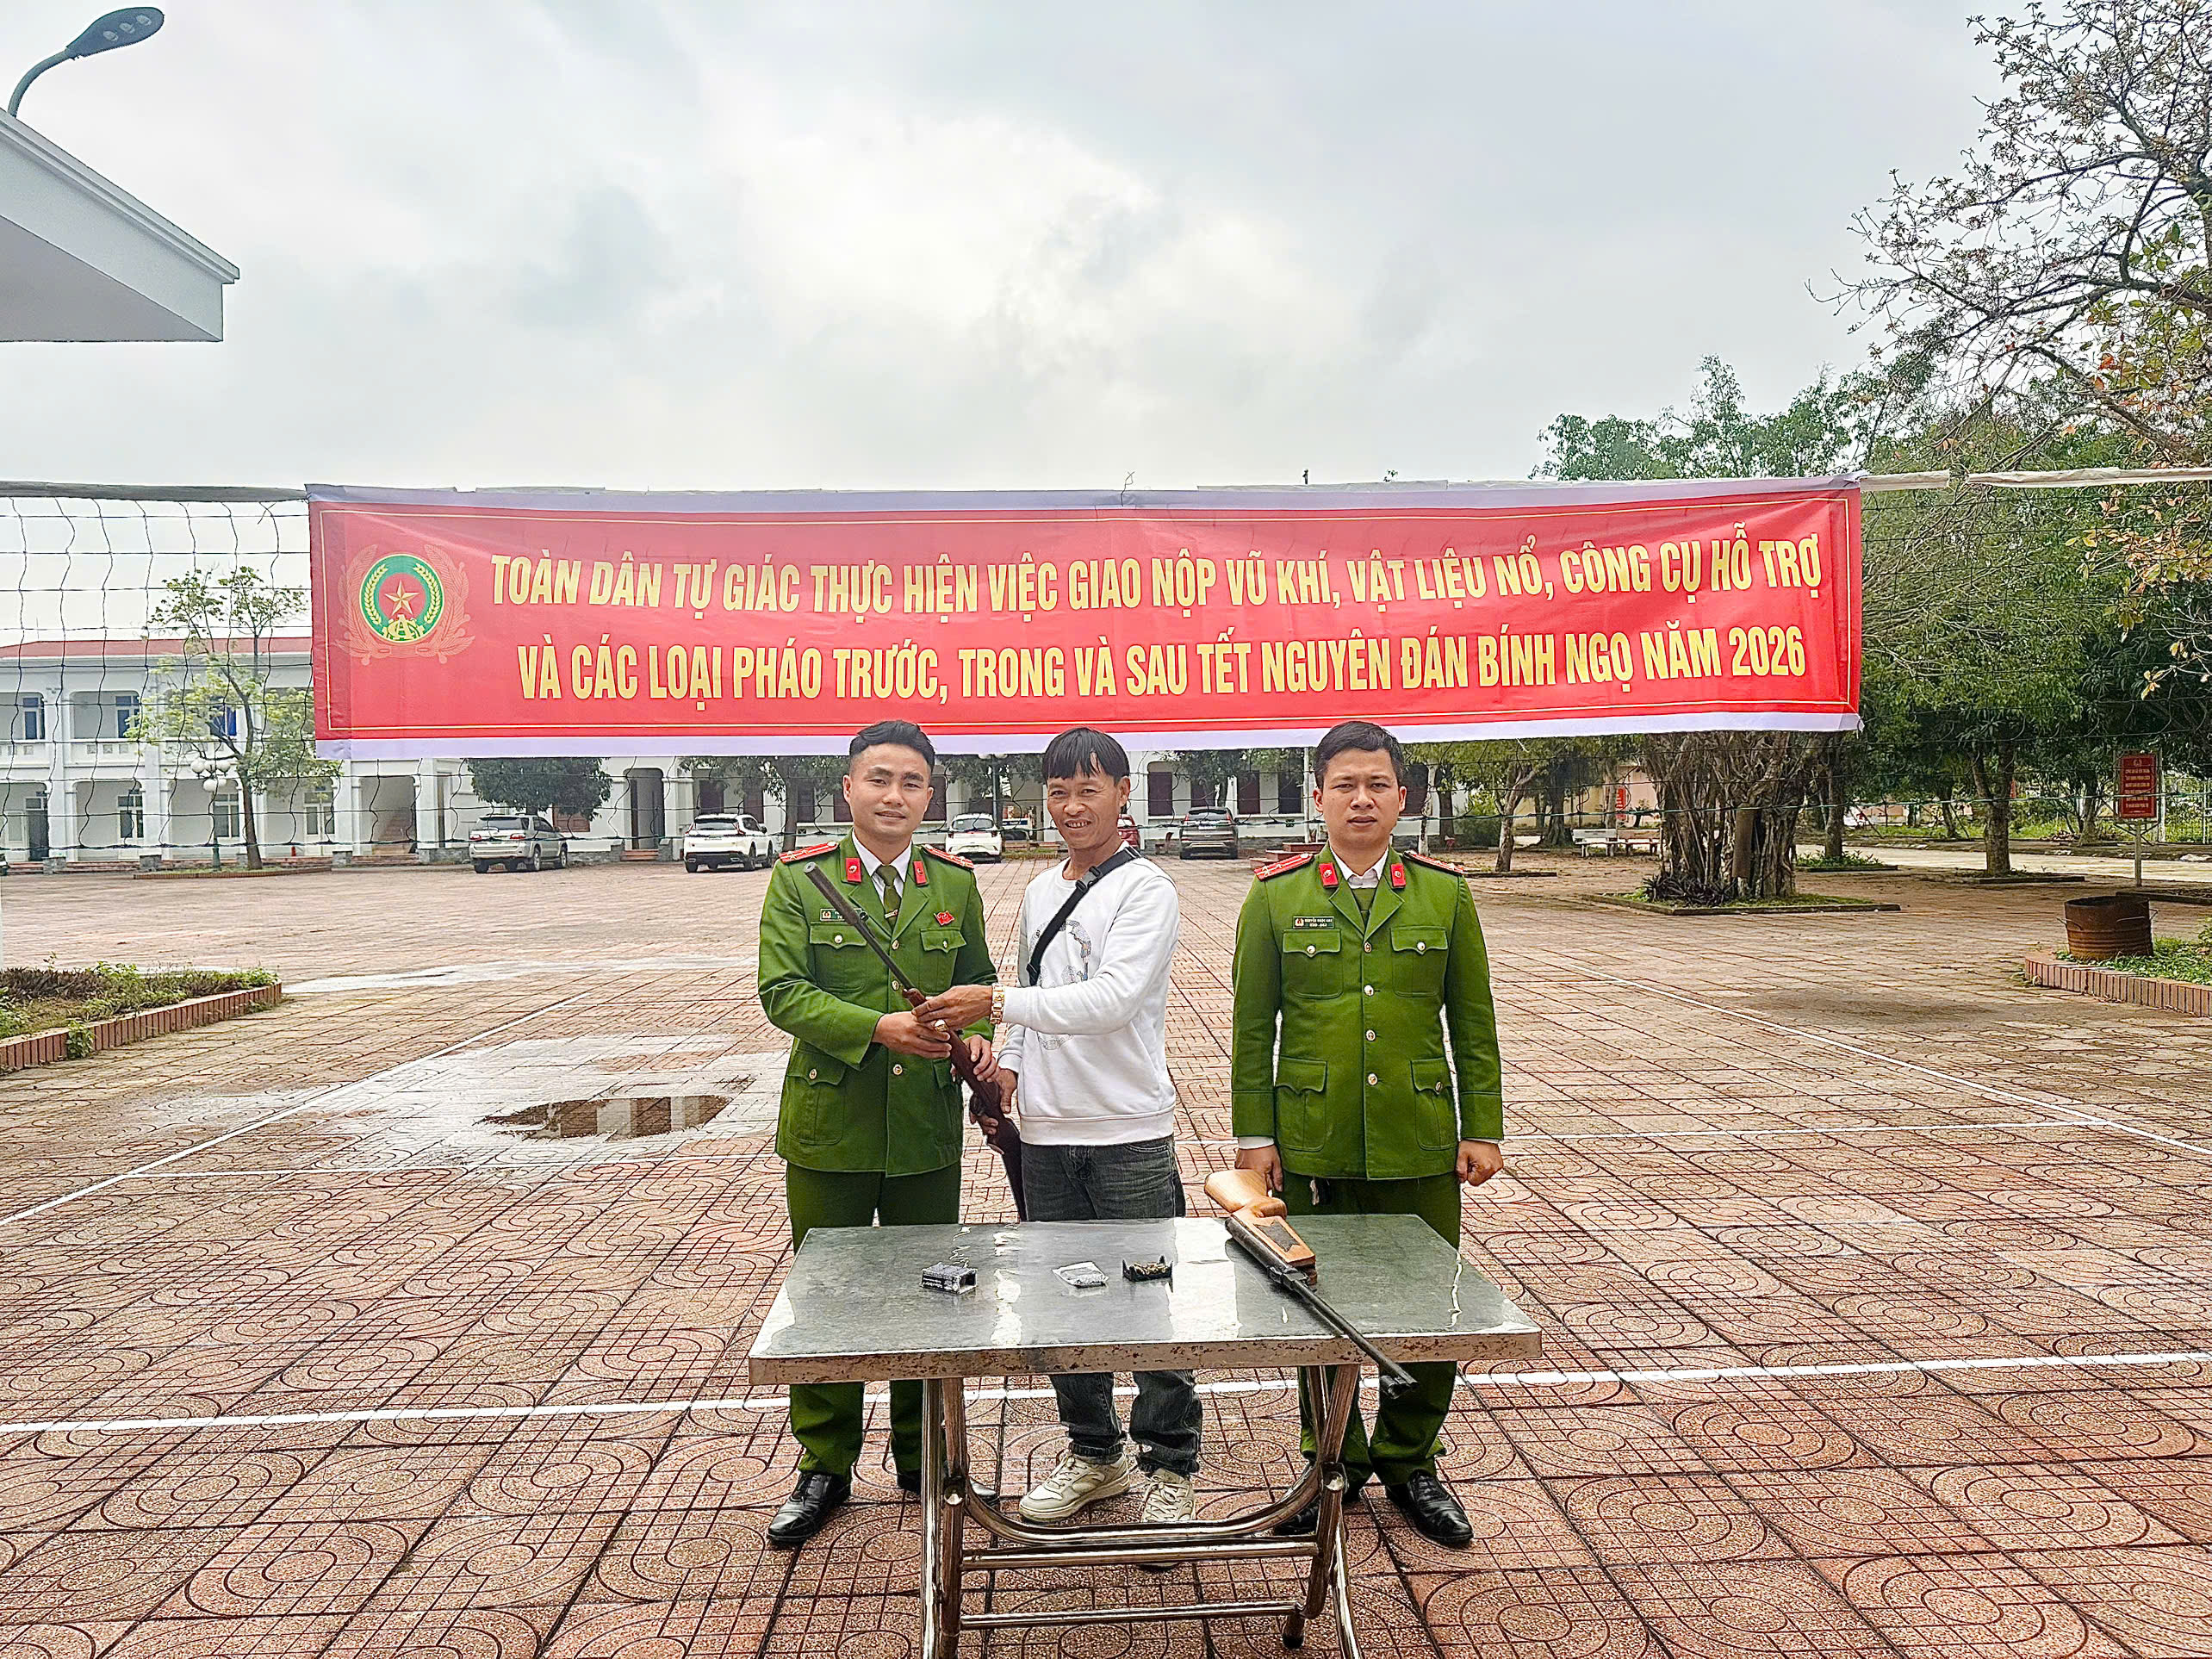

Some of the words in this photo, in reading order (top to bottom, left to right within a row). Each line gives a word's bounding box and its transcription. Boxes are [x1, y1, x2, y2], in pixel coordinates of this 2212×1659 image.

[490, 550, 582, 605] TOÀN
[588, 551, 663, 608] DÂN
[673, 558, 718, 619] TỰ
[724, 554, 800, 612] GIÁC
[811, 560, 893, 623] THỰC
[904, 554, 978, 623] HIỆN
[987, 552, 1059, 622] VIỆC
[1069, 558, 1142, 610] GIAO
[1152, 549, 1217, 618] NỘP
[1226, 550, 1267, 606] VŨ
[1277, 550, 1341, 610] KHÍ,
[1347, 550, 1406, 612] VẬT
[1414, 548, 1487, 609] LIỆU
[1494, 535, 1555, 601] NỔ,
[1560, 540, 1652, 596] CÔNG
[1661, 542, 1702, 605] CỤ
[1710, 521, 1754, 592] HỖ
[1757, 532, 1824, 600] TRỢ
[517, 634, 562, 700] VÀ
[571, 634, 638, 700] CÁC
[649, 646, 723, 711] LOẠI
[733, 637, 823, 699] PHÁO
[833, 639, 948, 705] TRƯỚC,
[959, 646, 1066, 698] TRONG
[1074, 636, 1117, 696] VÀ
[1126, 644, 1188, 696] SAU
[1196, 627, 1252, 694] TẾT
[1261, 629, 1391, 693] NGUYÊN
[1401, 625, 1469, 689] ĐÁN
[1479, 624, 1557, 687] BÍNH
[1565, 634, 1632, 693] NGỌ
[1639, 619, 1724, 680] NĂM
[1728, 626, 1807, 678] 2026
